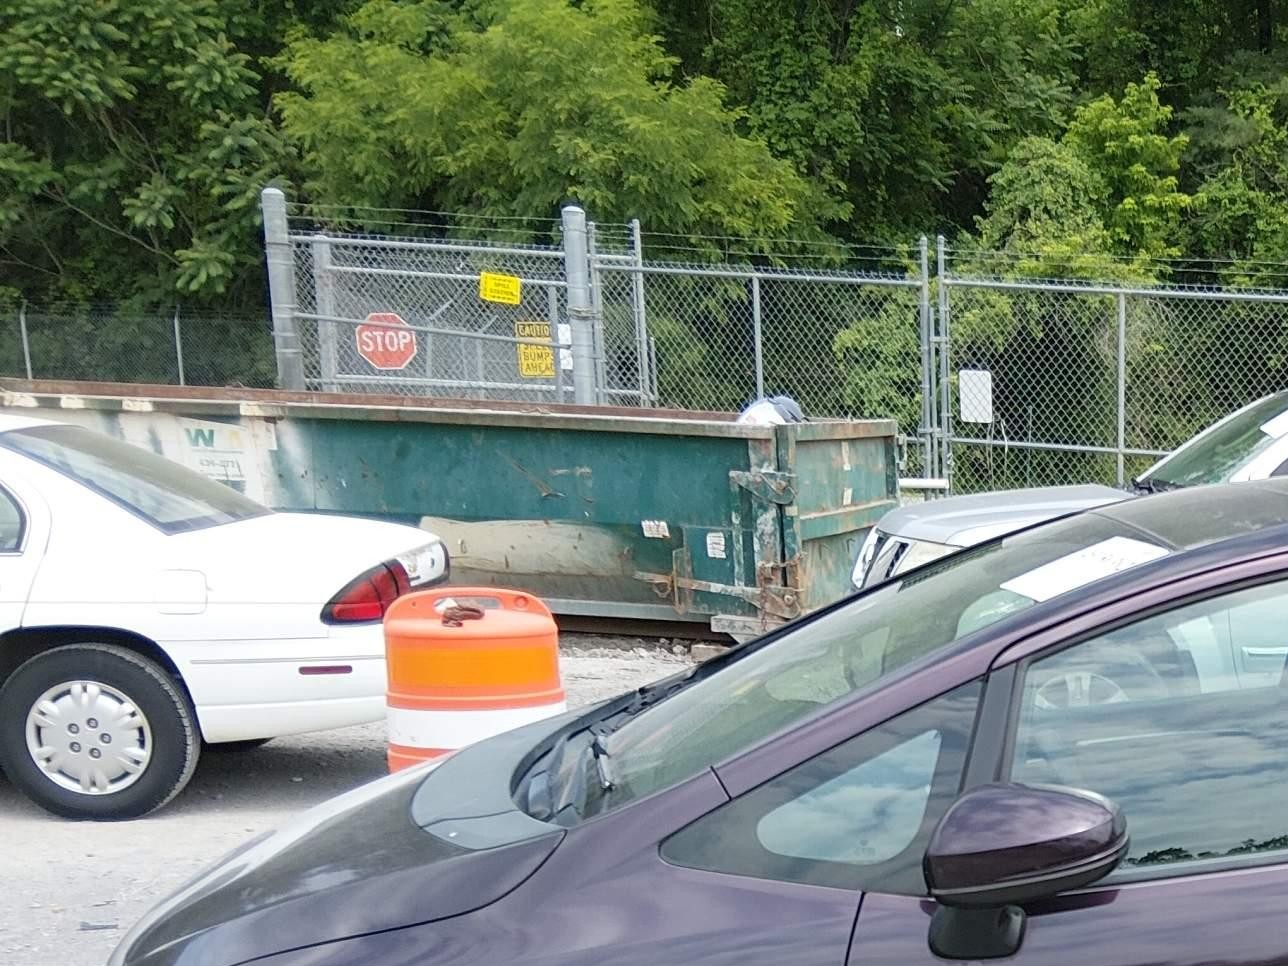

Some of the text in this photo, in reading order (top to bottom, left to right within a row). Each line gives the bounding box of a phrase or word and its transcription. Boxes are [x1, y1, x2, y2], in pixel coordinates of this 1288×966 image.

[518, 325, 551, 337] CAUTIO
[361, 330, 411, 352] STOP
[523, 352, 554, 361] BUMP
